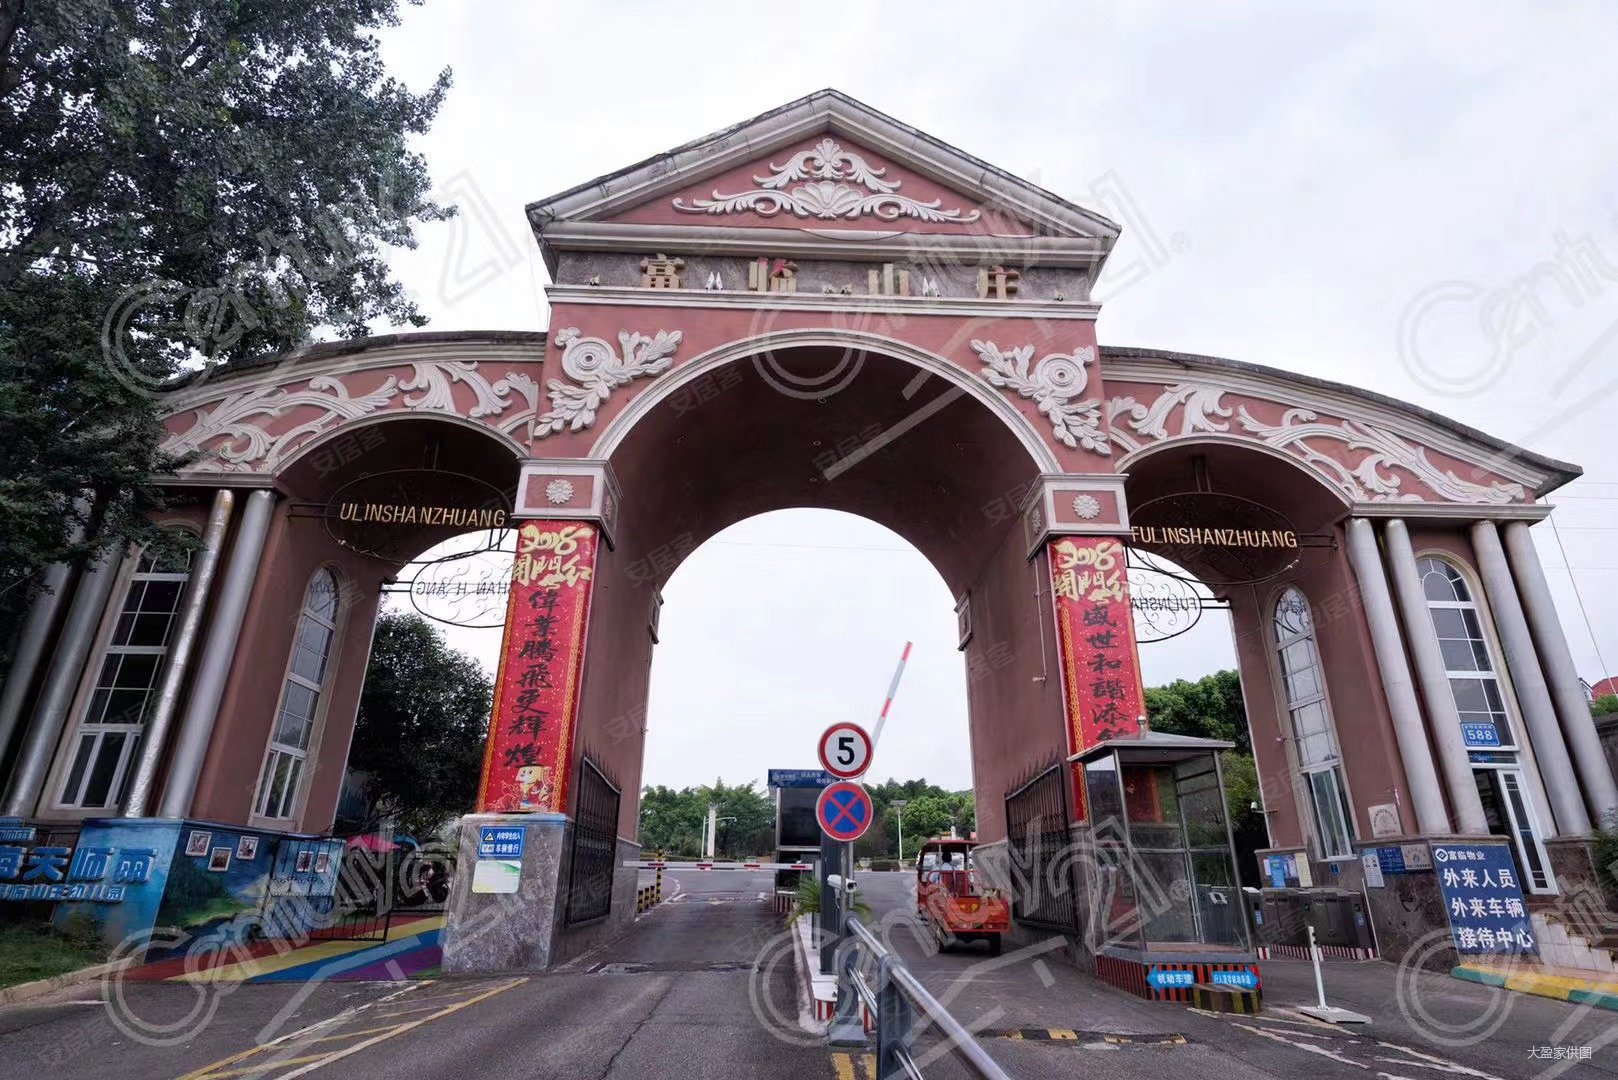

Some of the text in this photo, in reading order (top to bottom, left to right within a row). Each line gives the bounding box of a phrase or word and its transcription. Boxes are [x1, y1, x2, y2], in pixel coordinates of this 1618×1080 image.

[518, 524, 594, 555] 2018
[1131, 526, 1298, 548] FULINSHANZHUANG
[1055, 541, 1123, 571] 2018
[1467, 729, 1493, 740] 588
[837, 737, 855, 766] 5
[1448, 850, 1485, 860] 富临物业
[1443, 867, 1516, 889] 外来人员
[1451, 896, 1526, 918] 外来车辆
[1458, 926, 1534, 949] 接待中心
[1157, 973, 1194, 984] 机动车道
